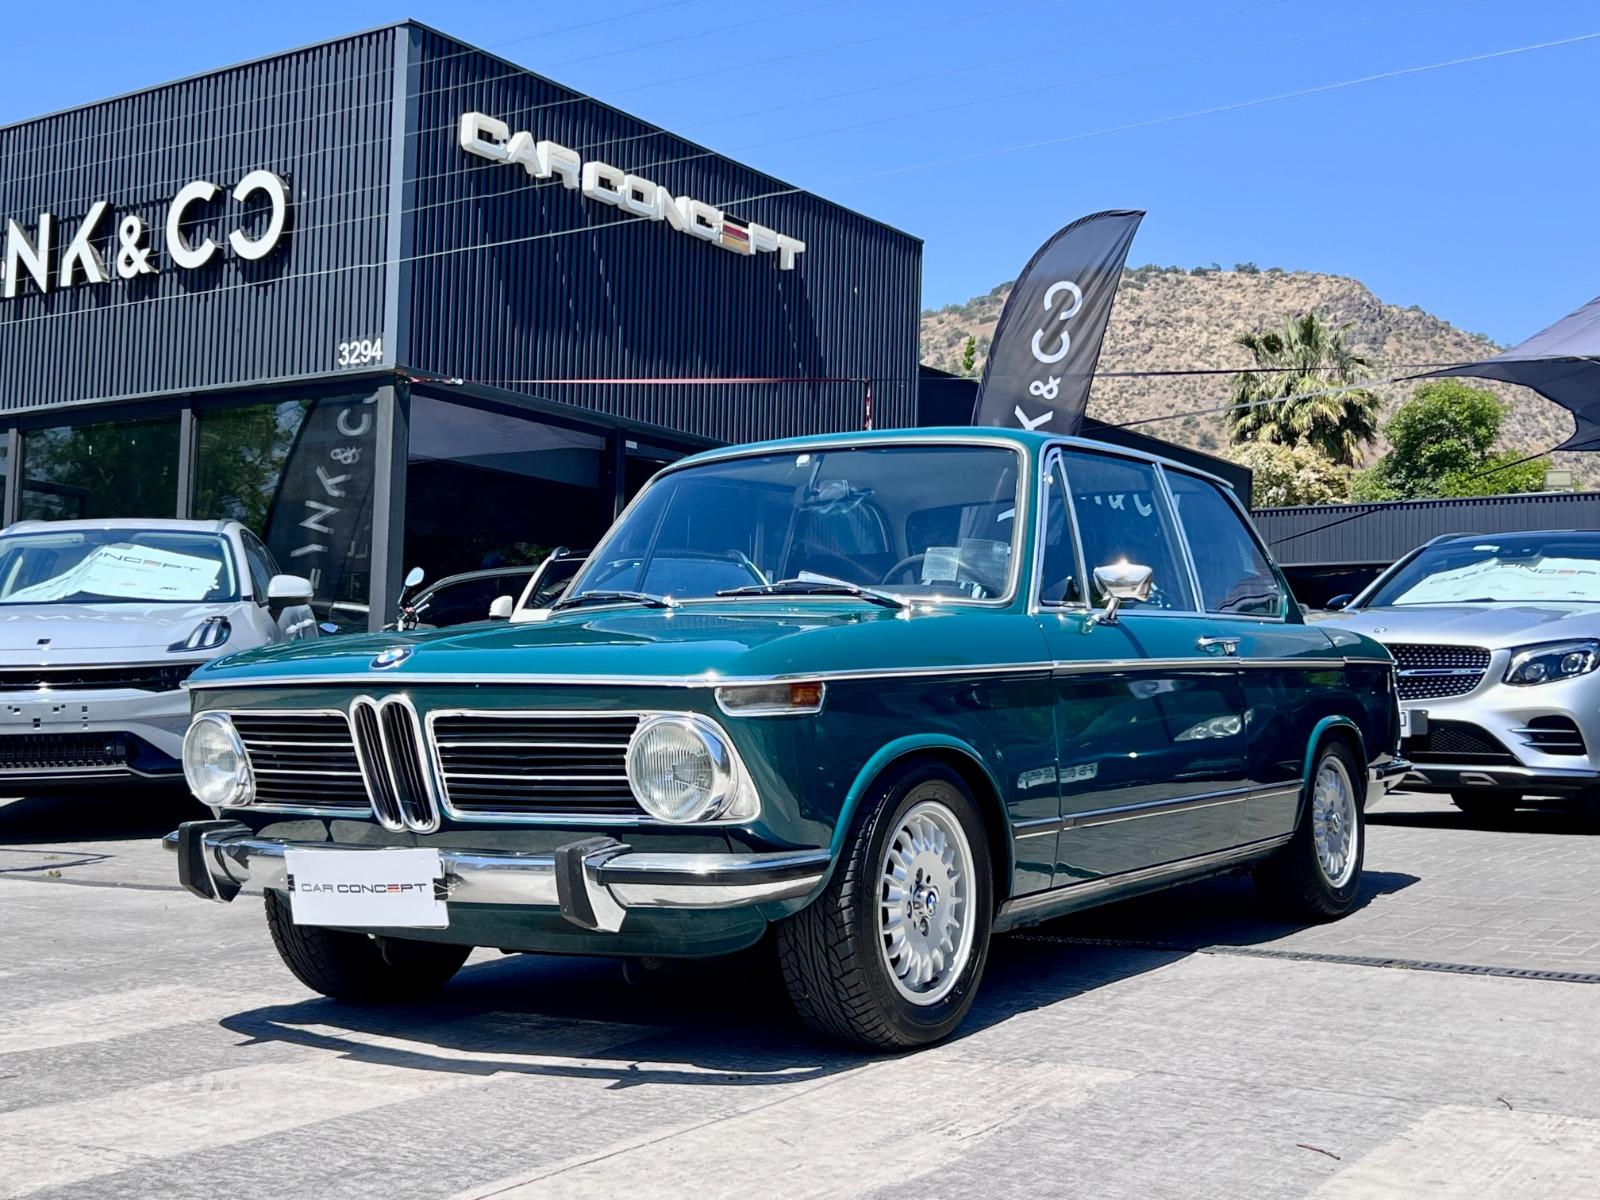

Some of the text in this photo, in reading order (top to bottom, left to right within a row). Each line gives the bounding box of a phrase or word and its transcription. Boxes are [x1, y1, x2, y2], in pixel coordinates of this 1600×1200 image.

[460, 111, 806, 271] CAR CONCEPT
[338, 337, 383, 366] 3294
[301, 883, 427, 894] CAR CONCEPT
